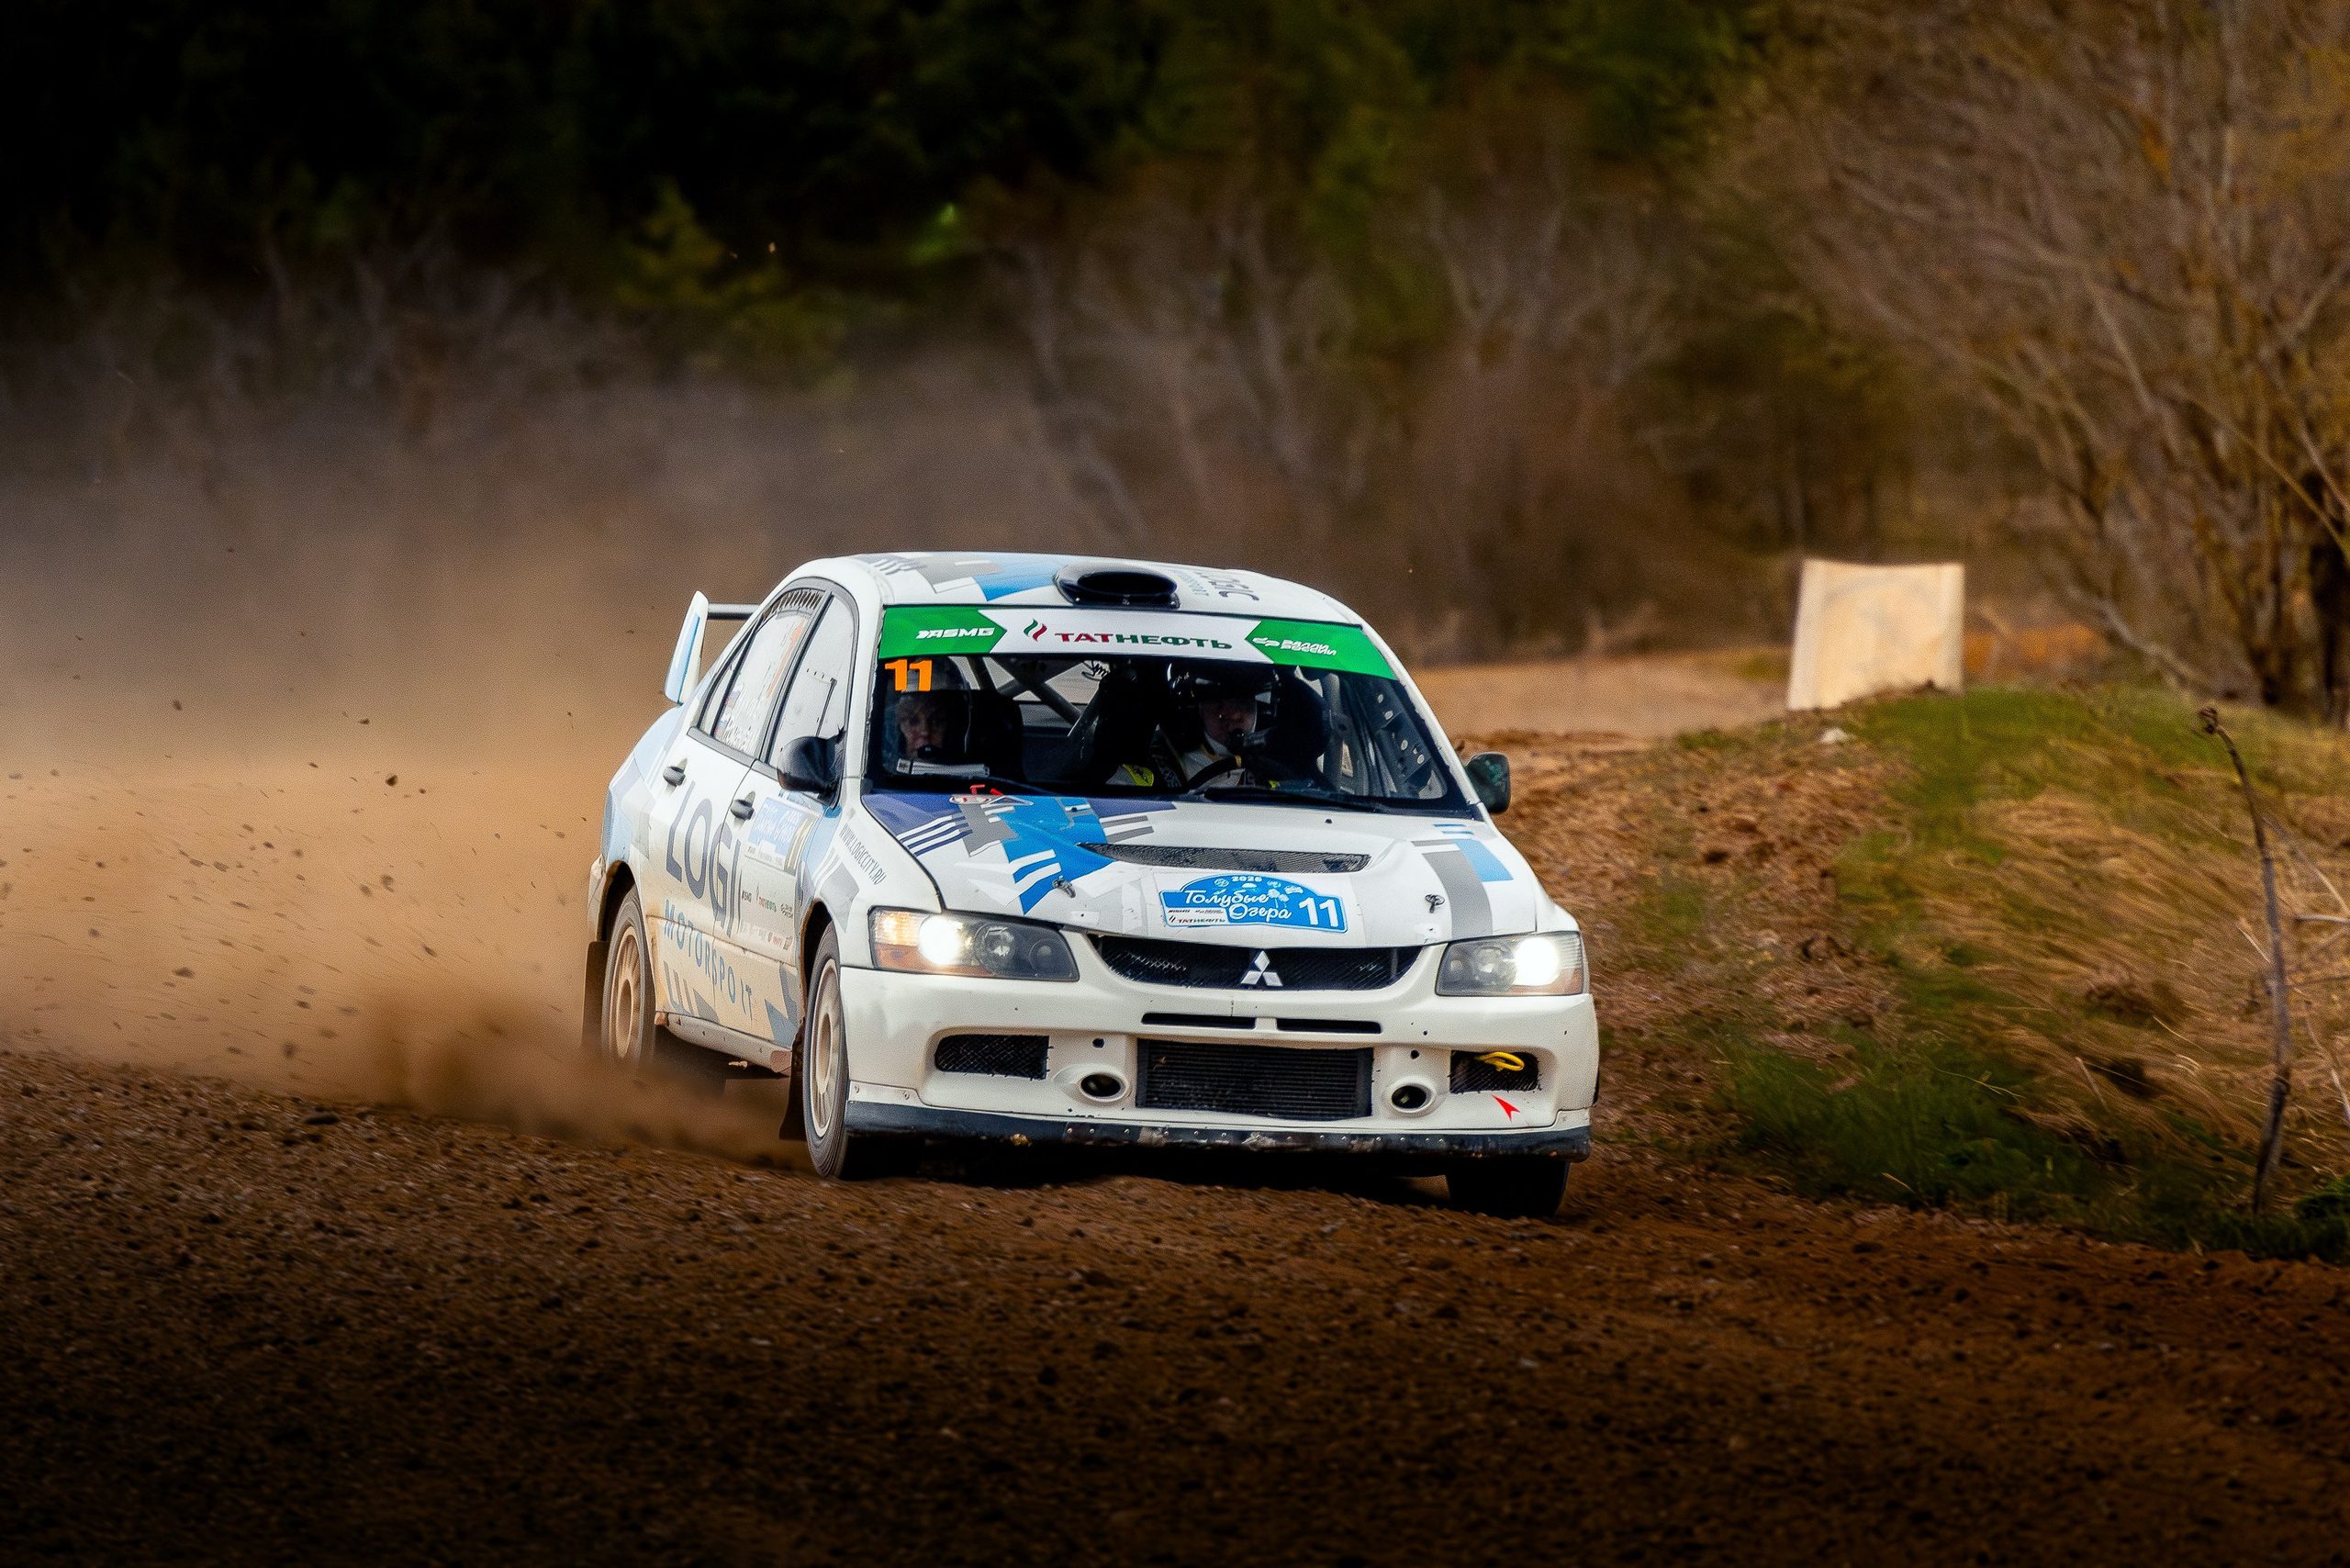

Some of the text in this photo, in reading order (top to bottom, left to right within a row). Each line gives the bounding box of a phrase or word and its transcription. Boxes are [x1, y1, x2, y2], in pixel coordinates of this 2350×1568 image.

[1055, 633, 1233, 650] ТАТНЕФТЬ
[884, 658, 933, 692] 11
[666, 780, 743, 938] LOGI
[839, 823, 887, 885] WWW.LOGICCITY.RU
[1184, 889, 1269, 908] Голубые
[1229, 903, 1292, 923] Озера
[1299, 897, 1339, 927] 11
